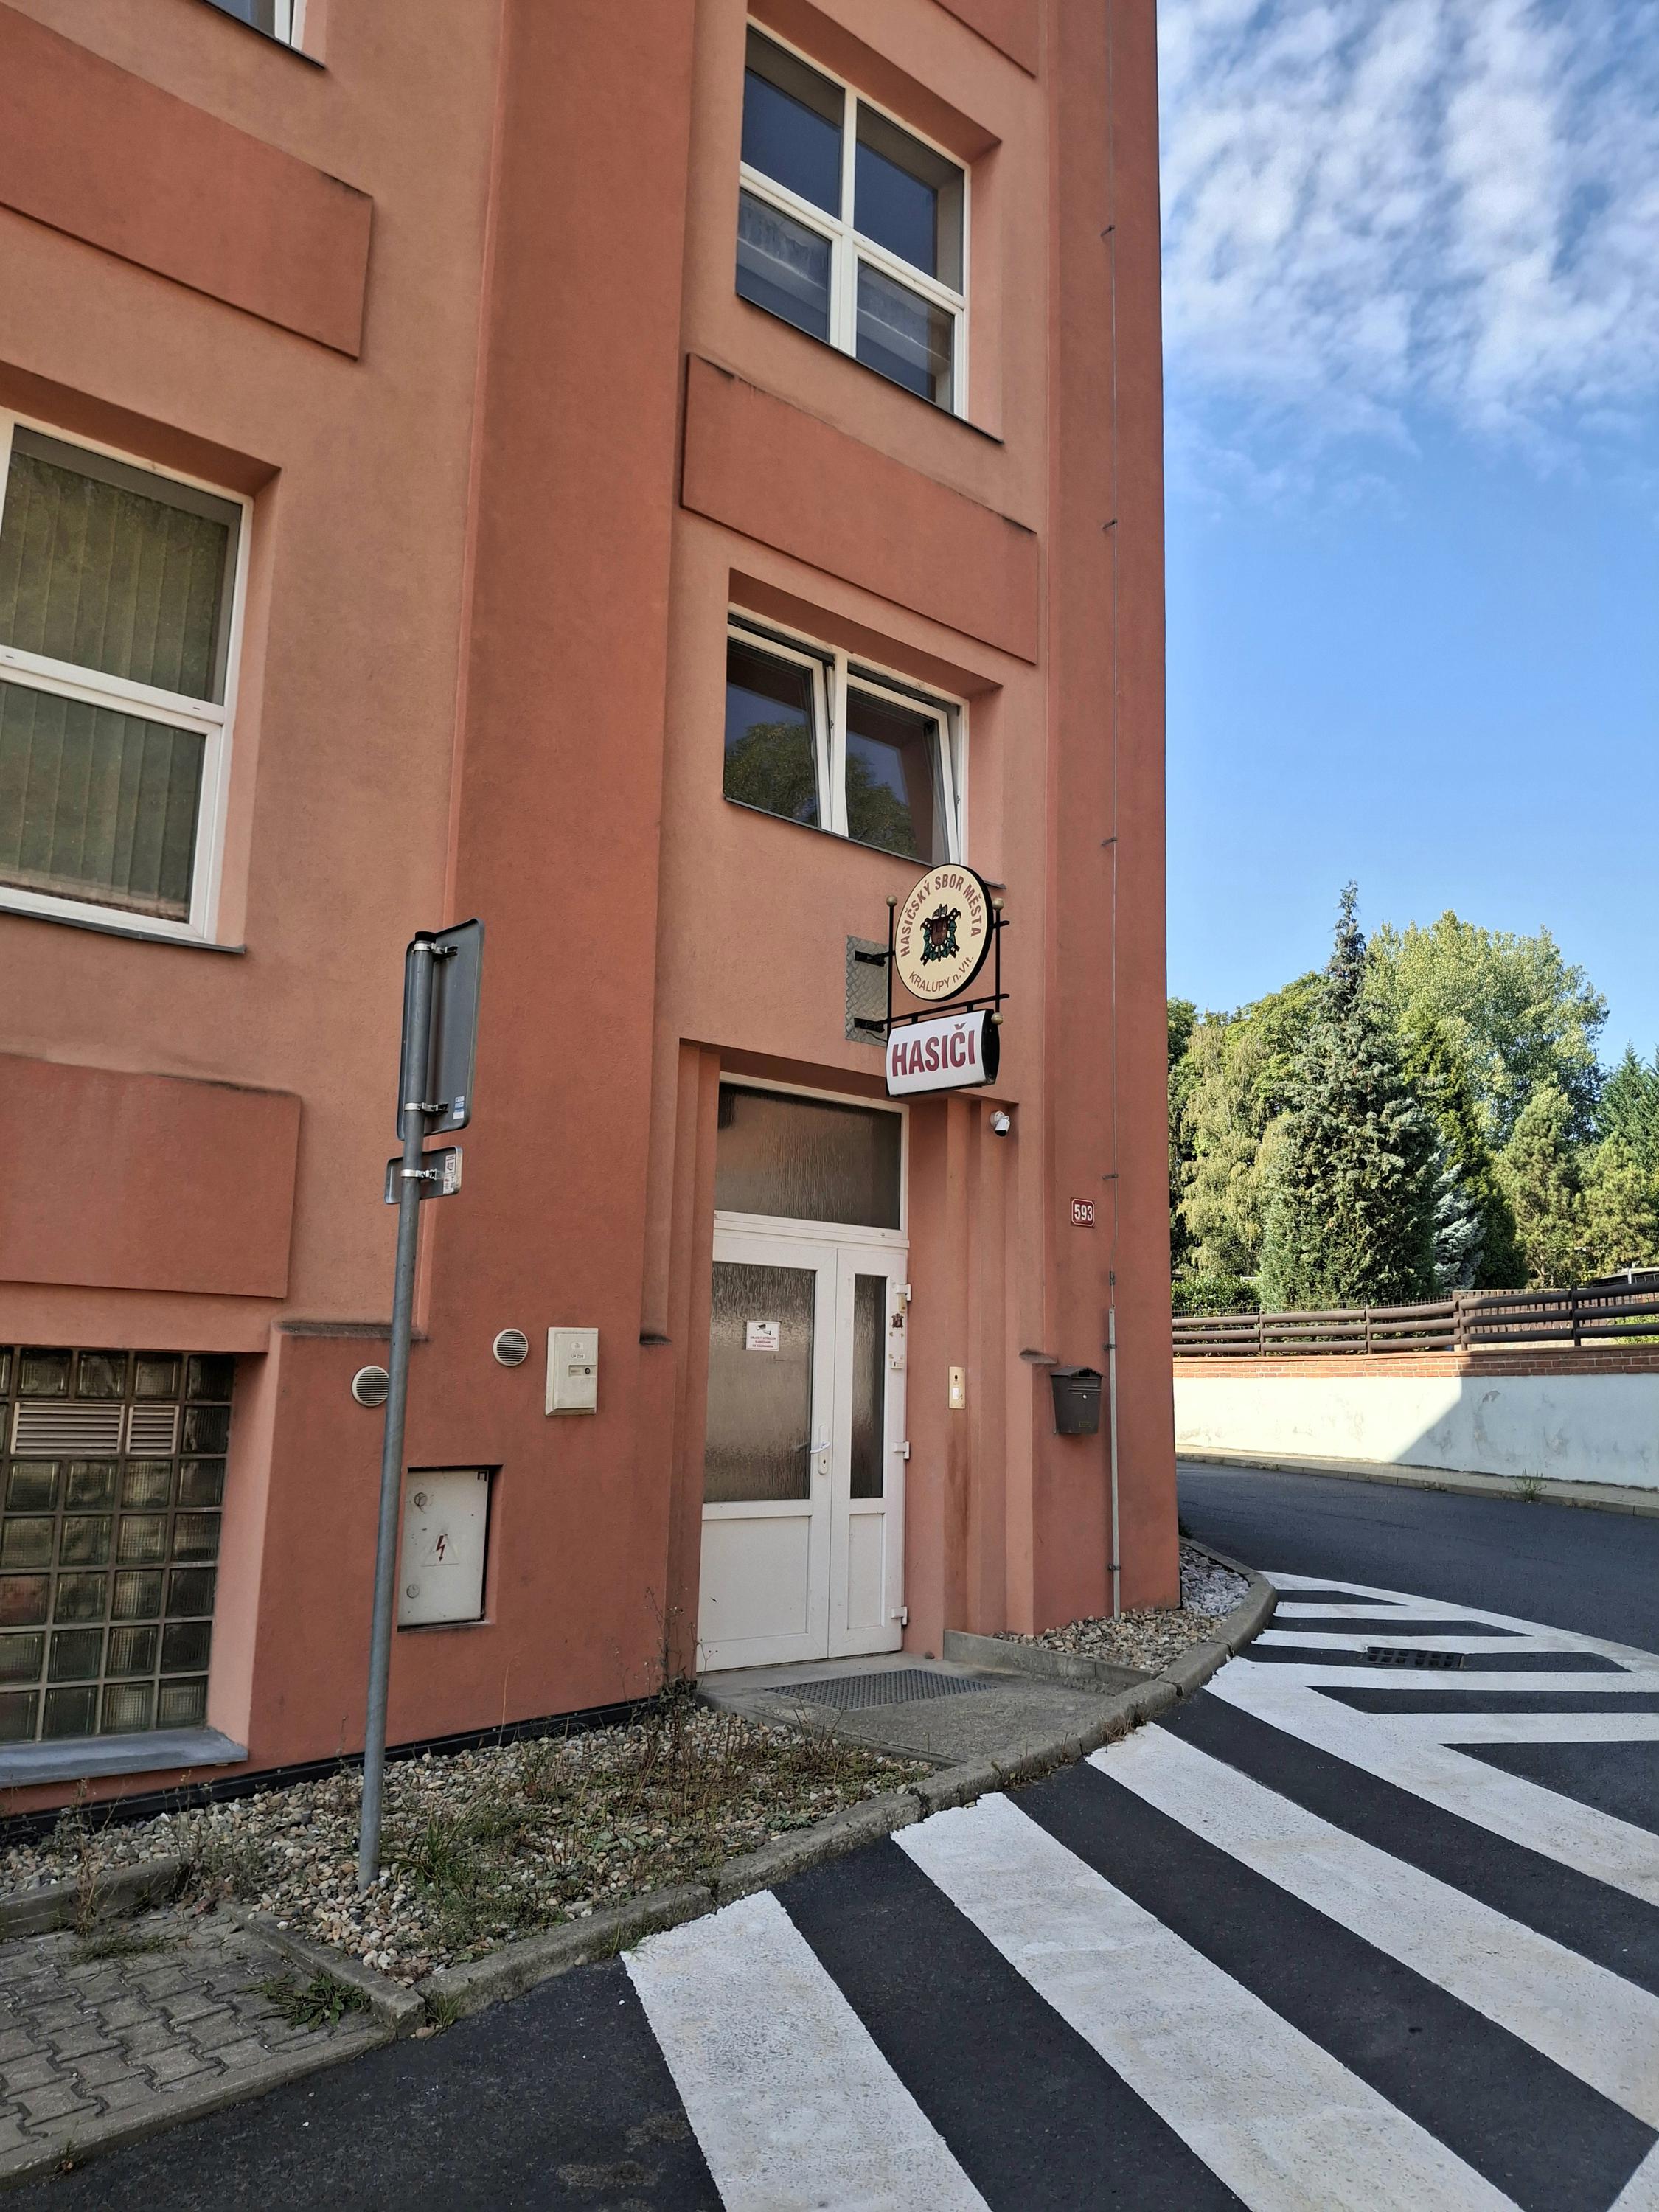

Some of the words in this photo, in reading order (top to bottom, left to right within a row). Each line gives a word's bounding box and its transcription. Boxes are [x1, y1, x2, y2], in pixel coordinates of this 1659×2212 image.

[900, 880, 931, 958] HASIČSKÝ
[935, 873, 964, 891] SBOR
[962, 883, 982, 937] MĚSTA
[908, 970, 950, 992] KRALUPY
[952, 974, 961, 983] n.
[959, 956, 974, 973] Vlt.
[892, 1022, 975, 1077] HASIČI
[1074, 1203, 1093, 1222] 593
